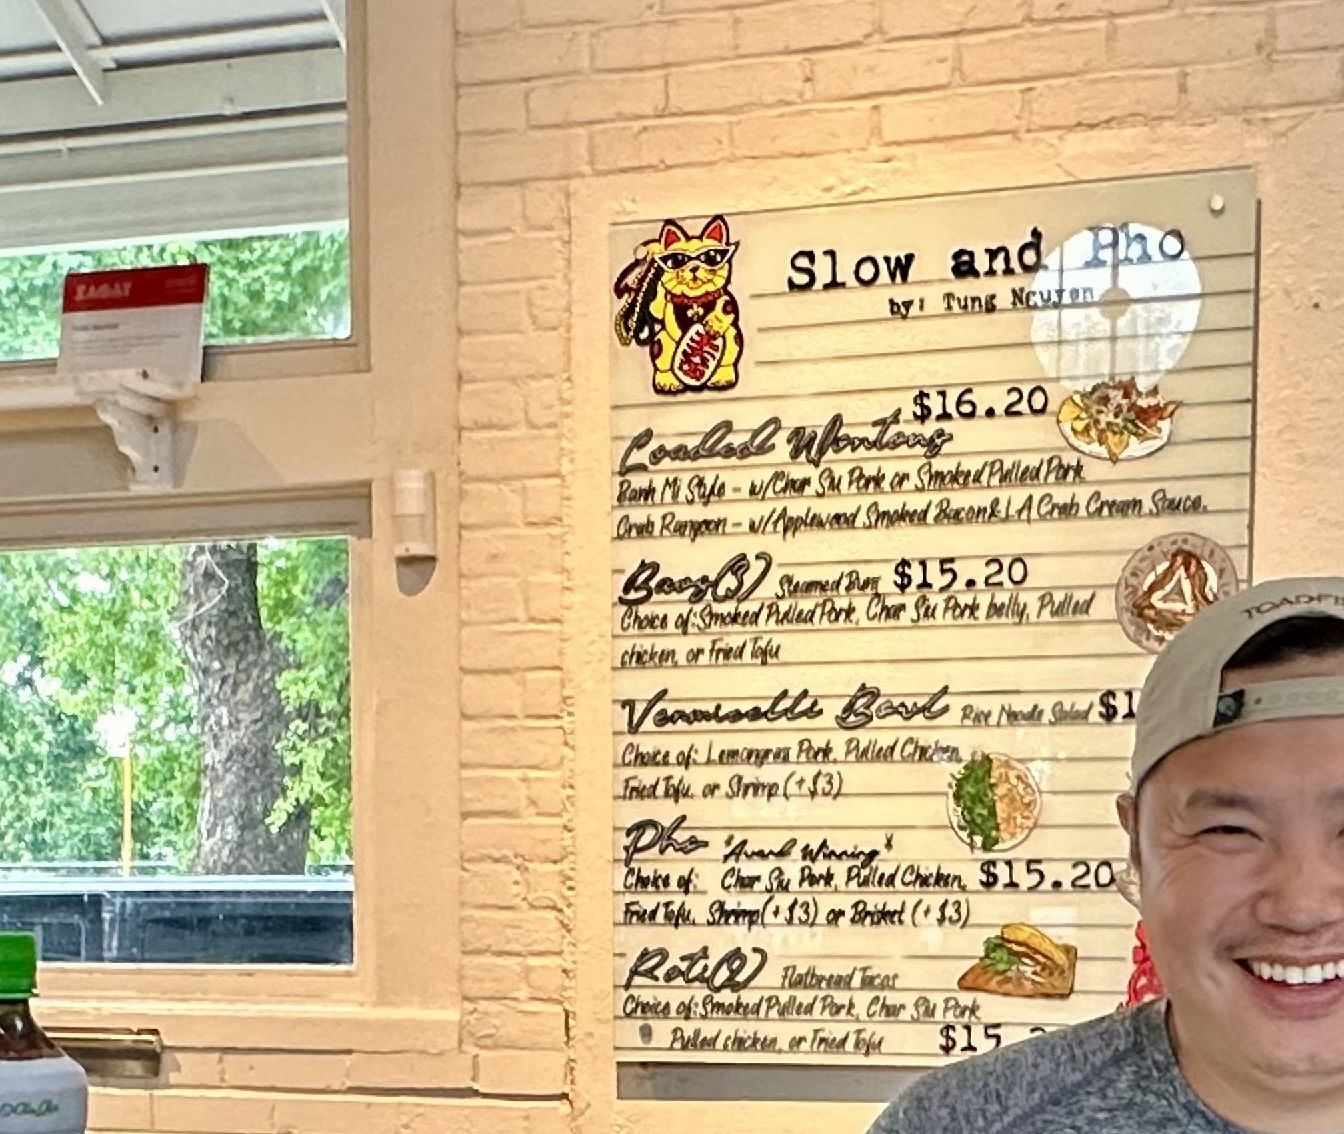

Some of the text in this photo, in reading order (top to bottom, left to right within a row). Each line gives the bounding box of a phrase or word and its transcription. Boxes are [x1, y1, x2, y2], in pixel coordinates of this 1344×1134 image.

[787, 225, 1186, 292] Slow and Pho
[943, 291, 997, 313] Tung
[913, 385, 1048, 423] $16.20
[619, 416, 782, 476] Loaded
[661, 475, 681, 504] Mi
[685, 472, 726, 506] Style
[848, 465, 885, 494] Pork
[890, 473, 909, 491] or
[915, 460, 987, 491] Smoked
[988, 457, 1045, 489] Pulled
[1045, 455, 1085, 484] Pork
[616, 512, 655, 539] Crab
[863, 500, 931, 528] Smoked
[1036, 492, 1079, 518] Crab
[1085, 490, 1142, 518] Cream
[776, 571, 843, 601] Steamed
[893, 556, 1028, 594] $15.20
[620, 604, 667, 631] Choice
[765, 599, 819, 627] Pulled
[866, 592, 906, 624] Char
[911, 593, 937, 624] Siu
[943, 593, 980, 622] Pork
[1037, 590, 1096, 620] Pulled
[686, 647, 705, 664] or
[709, 637, 747, 664] Fried
[750, 635, 781, 666] Tofu
[835, 682, 950, 730] Bowl
[1048, 700, 1094, 725] Salad
[622, 742, 670, 767] Choice
[845, 737, 898, 762] Pulled
[623, 776, 658, 801] Fried
[702, 783, 721, 798] or
[725, 773, 780, 802] Shrimp
[623, 814, 709, 867] Pho
[623, 867, 670, 891] Choice
[720, 867, 761, 892] Char
[765, 866, 792, 893] Siu
[845, 863, 899, 889] Pulled
[979, 858, 1114, 891] $15.20
[623, 900, 659, 925] Fried
[707, 899, 760, 932] Shrimp
[826, 908, 846, 927] or
[780, 965, 899, 990] Flatbread Tacos
[623, 994, 670, 1017] Choice
[700, 993, 765, 1018] Smoked
[765, 994, 820, 1018] Pulled
[866, 996, 905, 1019] Char
[910, 996, 937, 1021] Siu
[943, 996, 982, 1020] Pork
[671, 1026, 722, 1050] Pulled
[789, 1034, 807, 1048] or
[854, 1026, 884, 1057] Tofu
